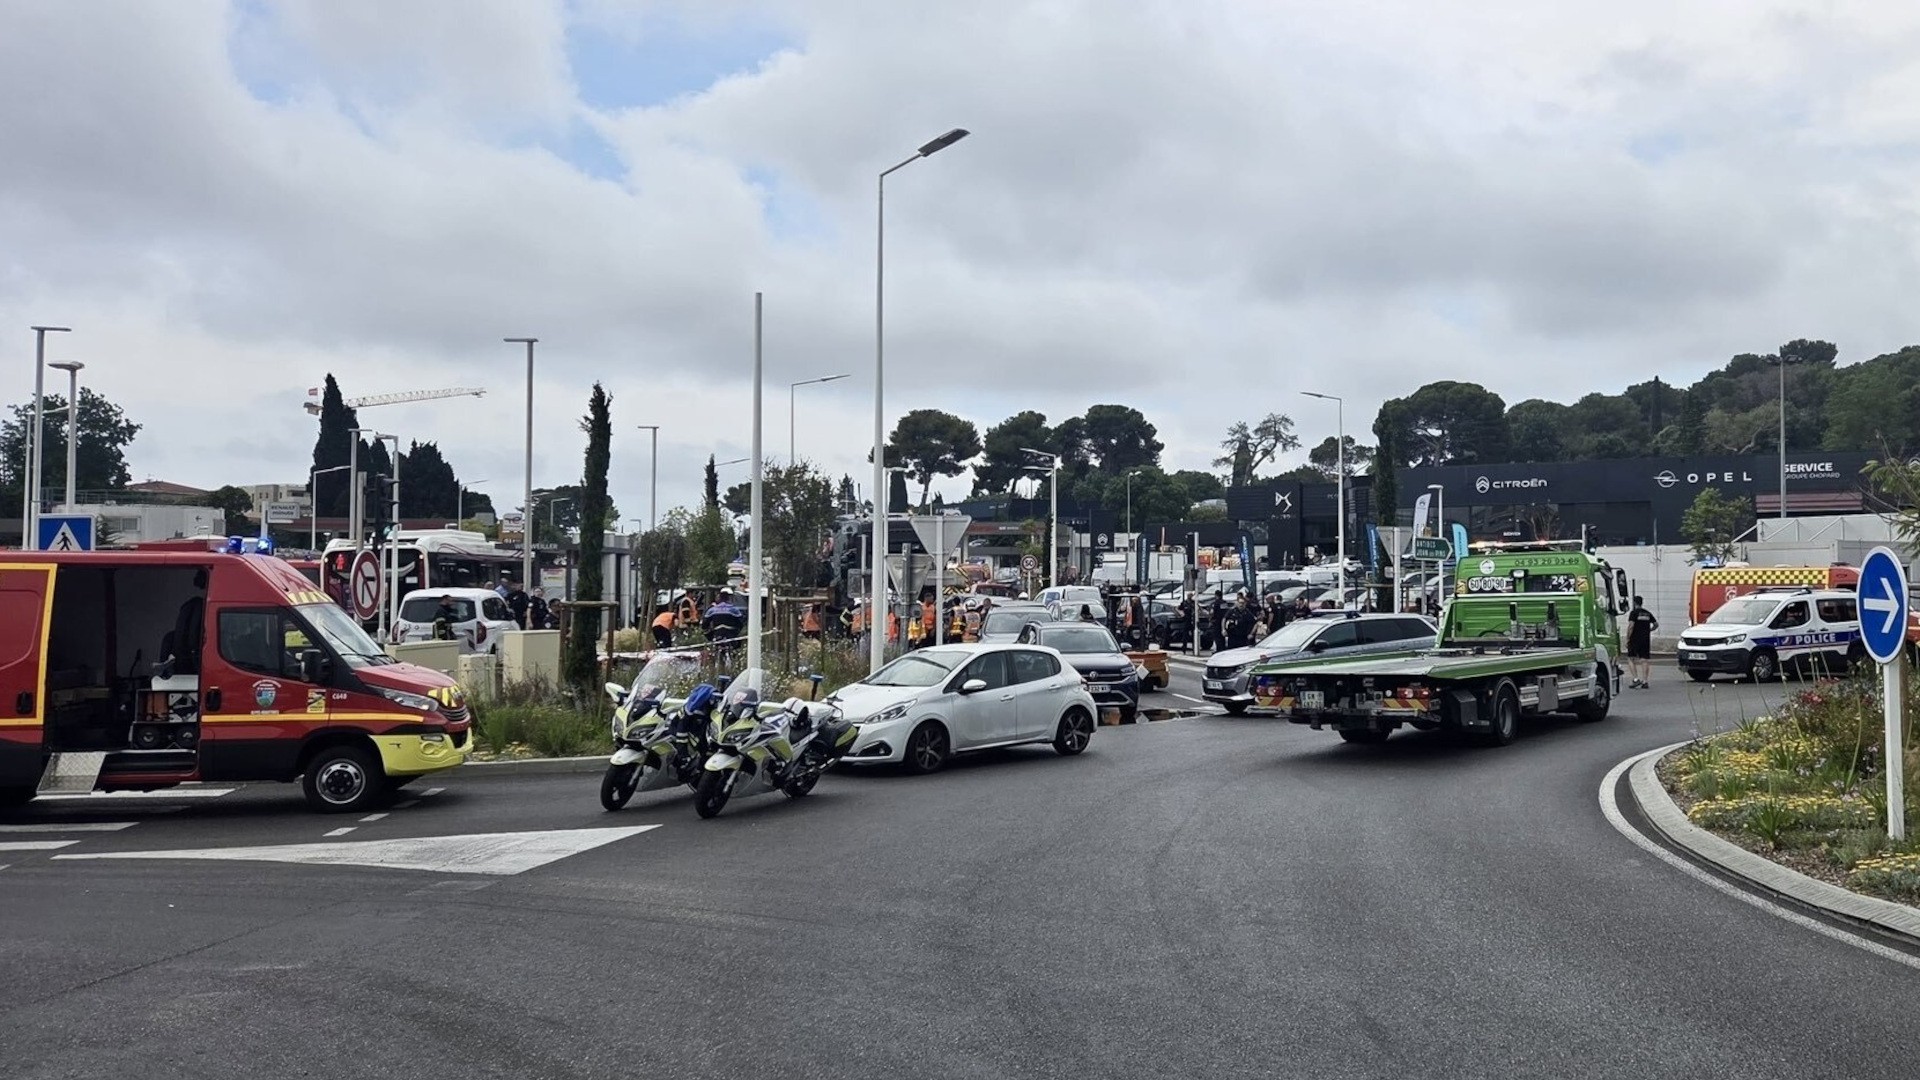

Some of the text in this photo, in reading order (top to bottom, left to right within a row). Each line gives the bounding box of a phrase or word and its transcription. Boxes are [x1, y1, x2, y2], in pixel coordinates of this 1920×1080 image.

[1784, 462, 1833, 473] SERVICE
[1687, 471, 1752, 483] OPEL
[1416, 540, 1436, 548] ANTIBES
[1025, 559, 1034, 567] 50
[1795, 633, 1836, 645] POLICE
